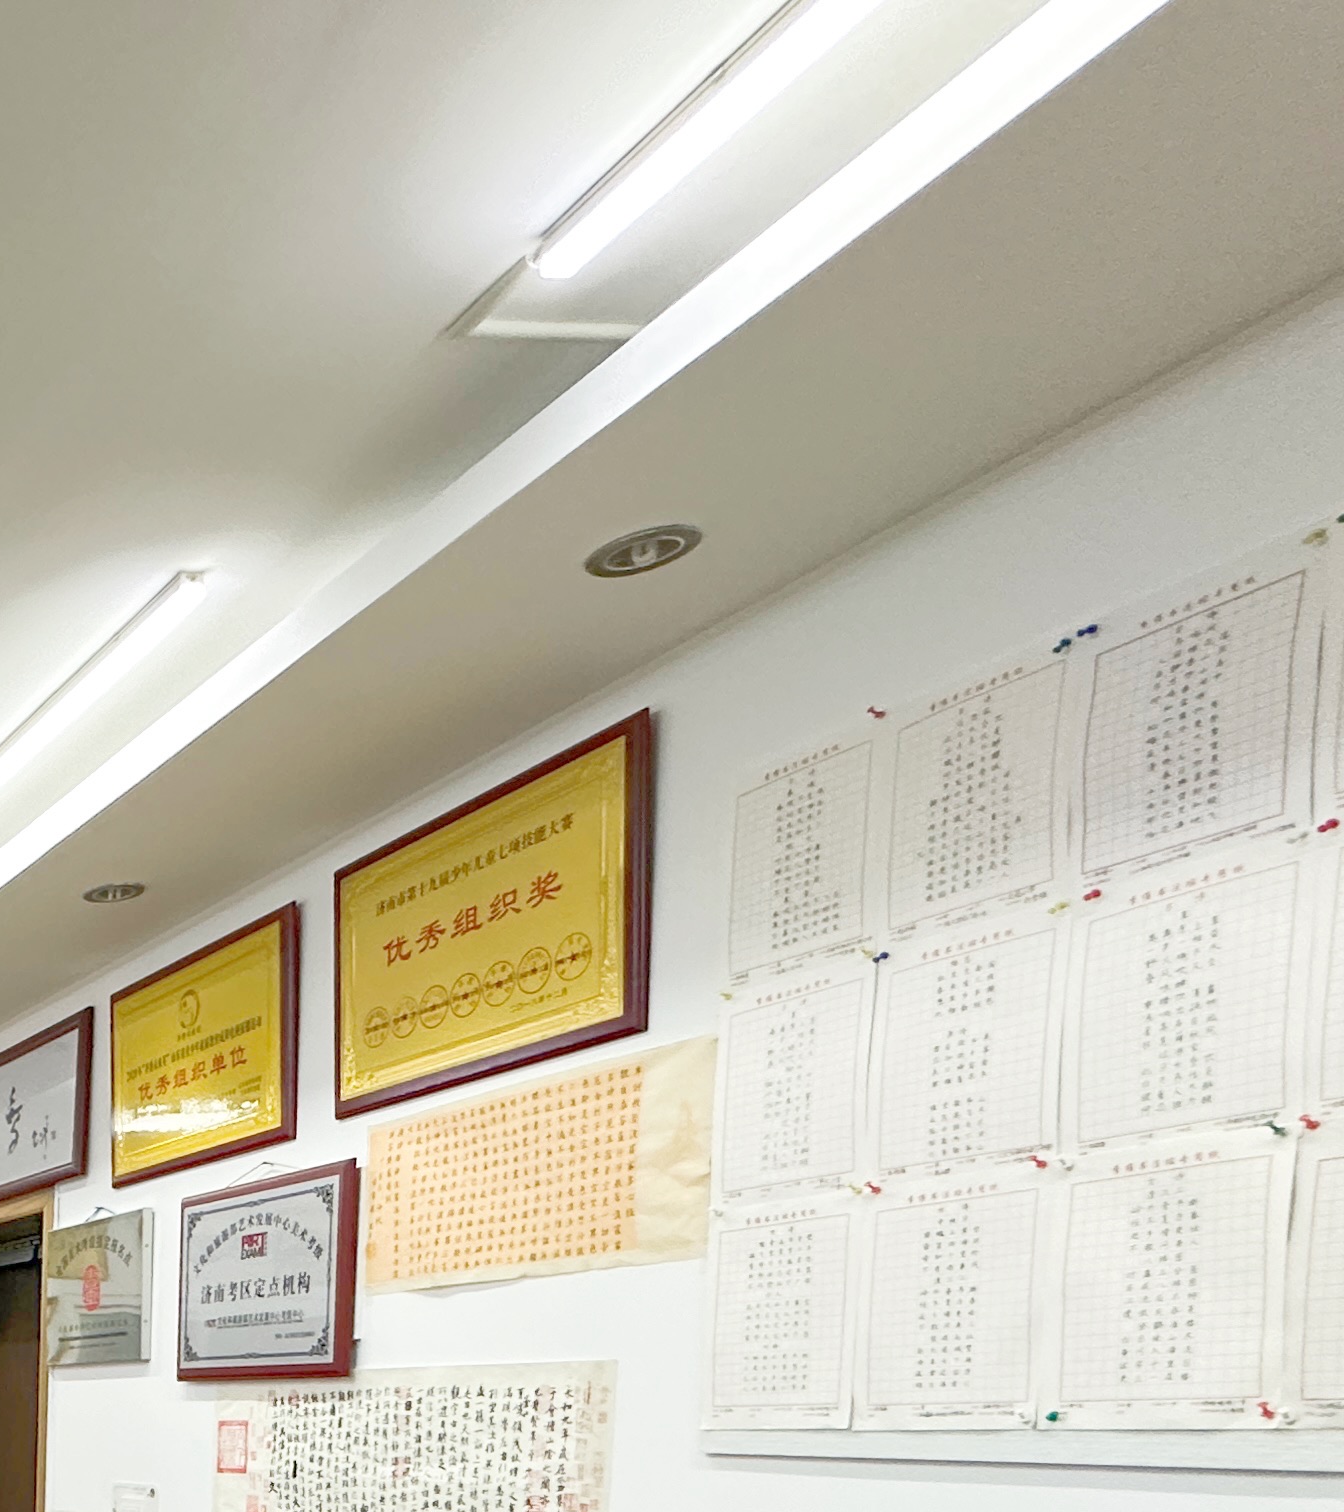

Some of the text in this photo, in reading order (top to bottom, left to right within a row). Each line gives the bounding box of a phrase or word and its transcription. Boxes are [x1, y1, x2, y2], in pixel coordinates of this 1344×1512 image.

[381, 869, 565, 968] 优秀组织奖
[137, 1044, 249, 1102] 优秀组织单位
[200, 1271, 312, 1305] 济南考区定点机构
